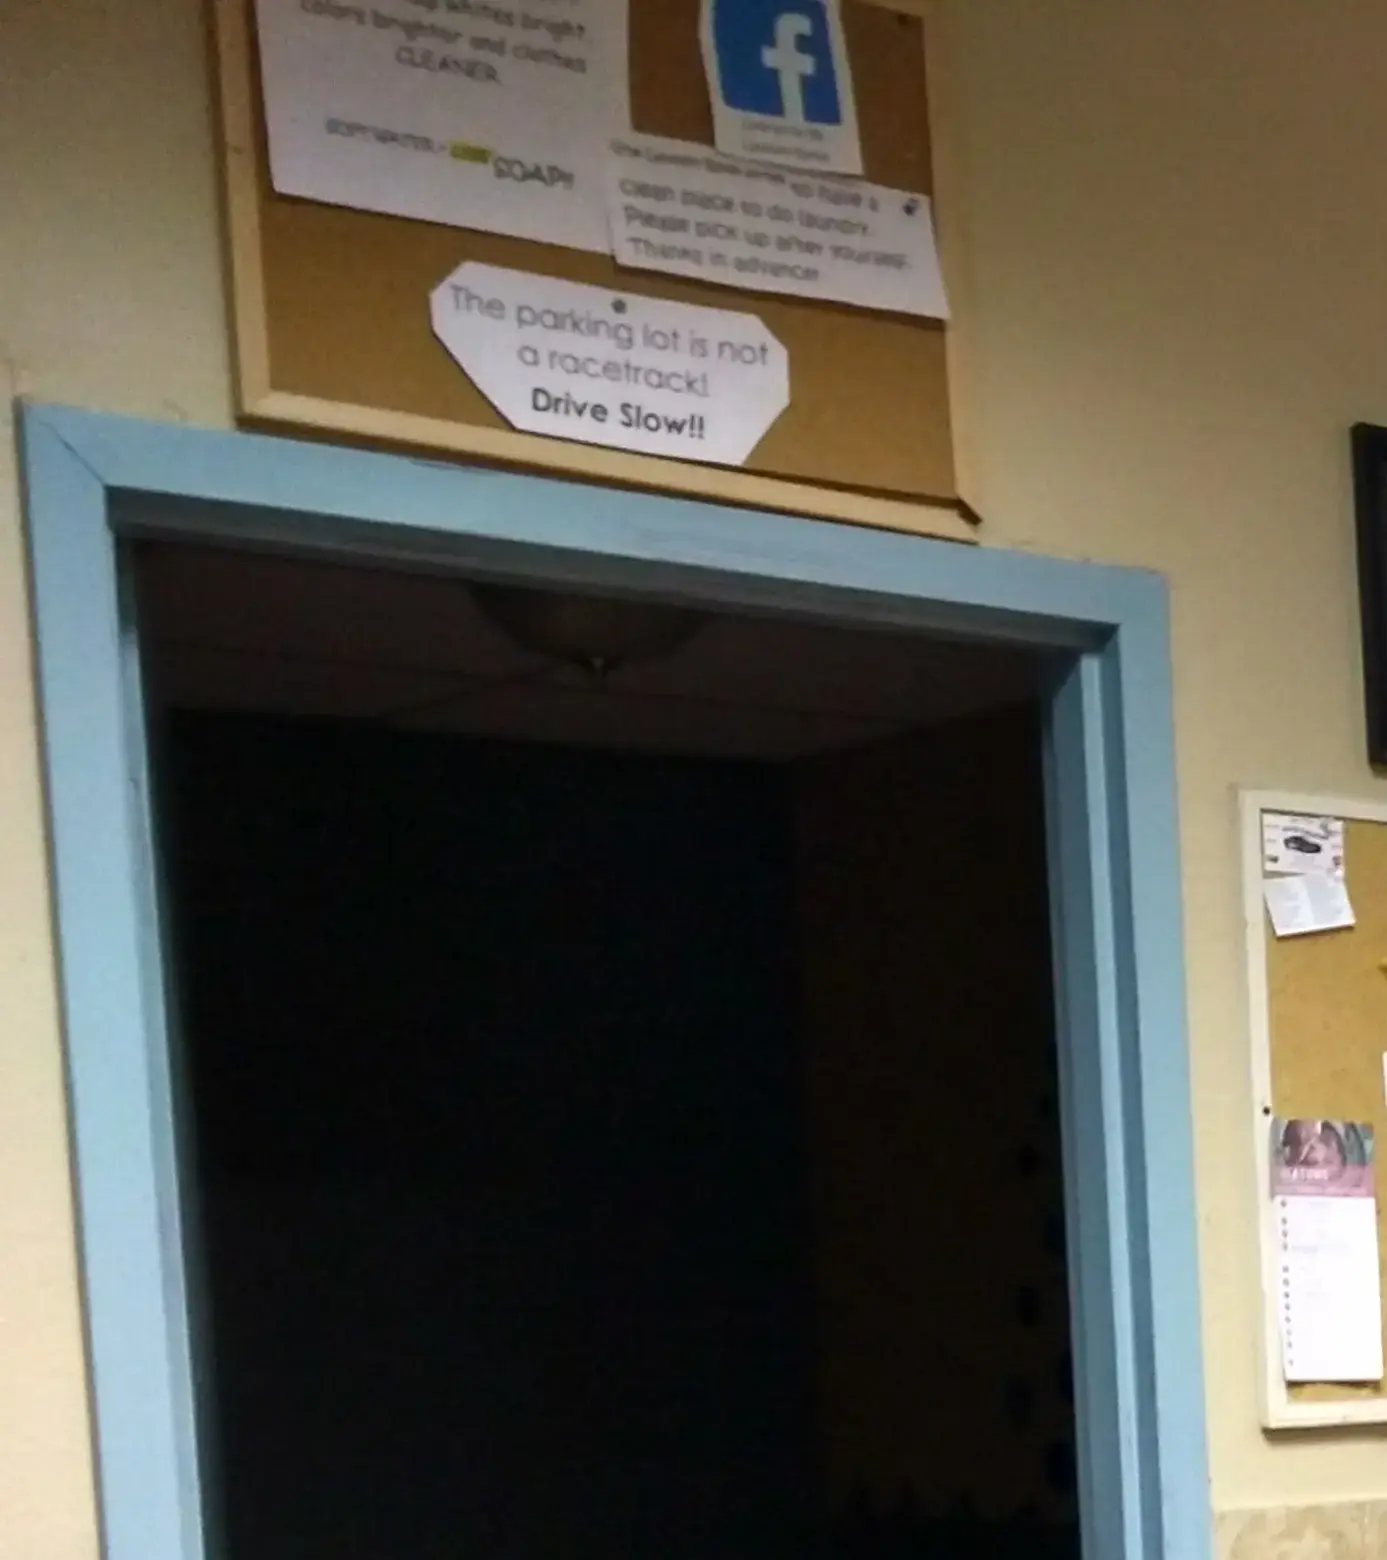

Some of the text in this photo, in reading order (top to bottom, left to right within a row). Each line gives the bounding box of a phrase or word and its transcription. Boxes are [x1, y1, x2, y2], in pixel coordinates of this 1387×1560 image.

[451, 284, 769, 366] The parking lot is not
[517, 345, 711, 397] a racetrack!
[531, 387, 705, 440] Drive Slow!!
